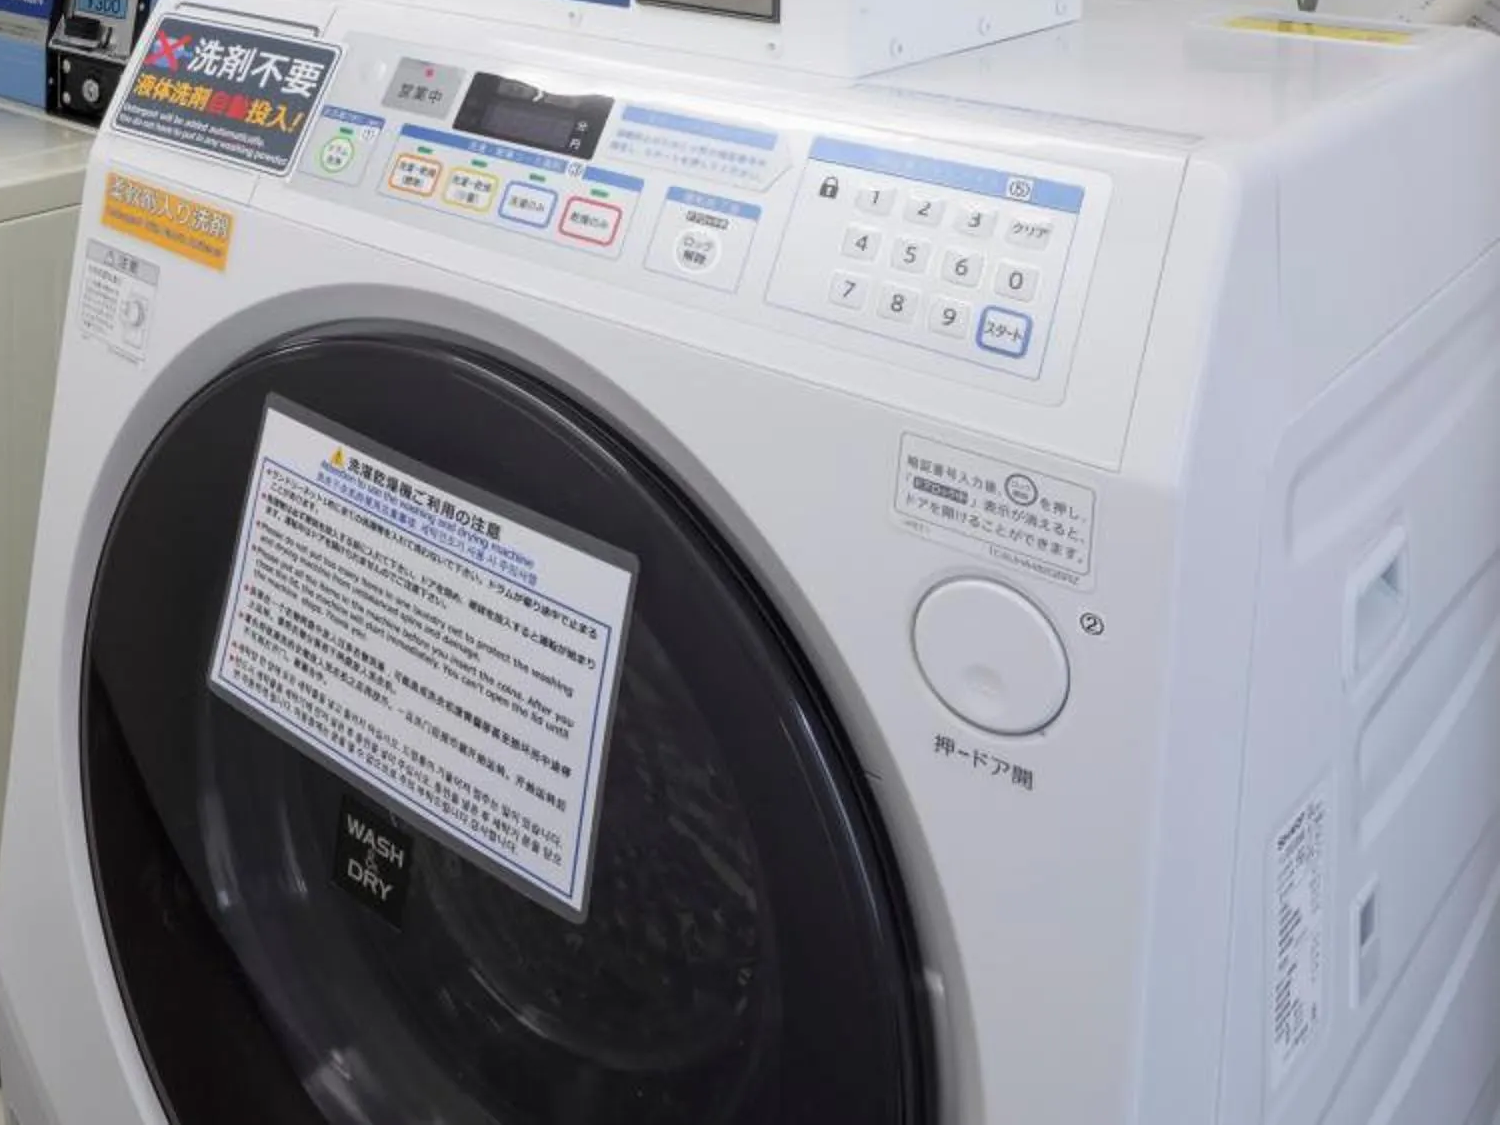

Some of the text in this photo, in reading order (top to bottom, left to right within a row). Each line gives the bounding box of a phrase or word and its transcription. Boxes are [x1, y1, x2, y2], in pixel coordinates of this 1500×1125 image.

[187, 37, 325, 99] 洗剤不要
[871, 190, 880, 205] 1
[917, 201, 932, 217] 2
[967, 212, 982, 228] 3
[854, 234, 868, 252] 4
[903, 246, 917, 264] 5
[954, 258, 969, 277] 6
[843, 280, 857, 299] 7
[1008, 271, 1024, 291] 0
[889, 293, 905, 313] 8
[941, 307, 958, 327] 9
[346, 813, 405, 868] WASH
[347, 859, 395, 902] DRY
